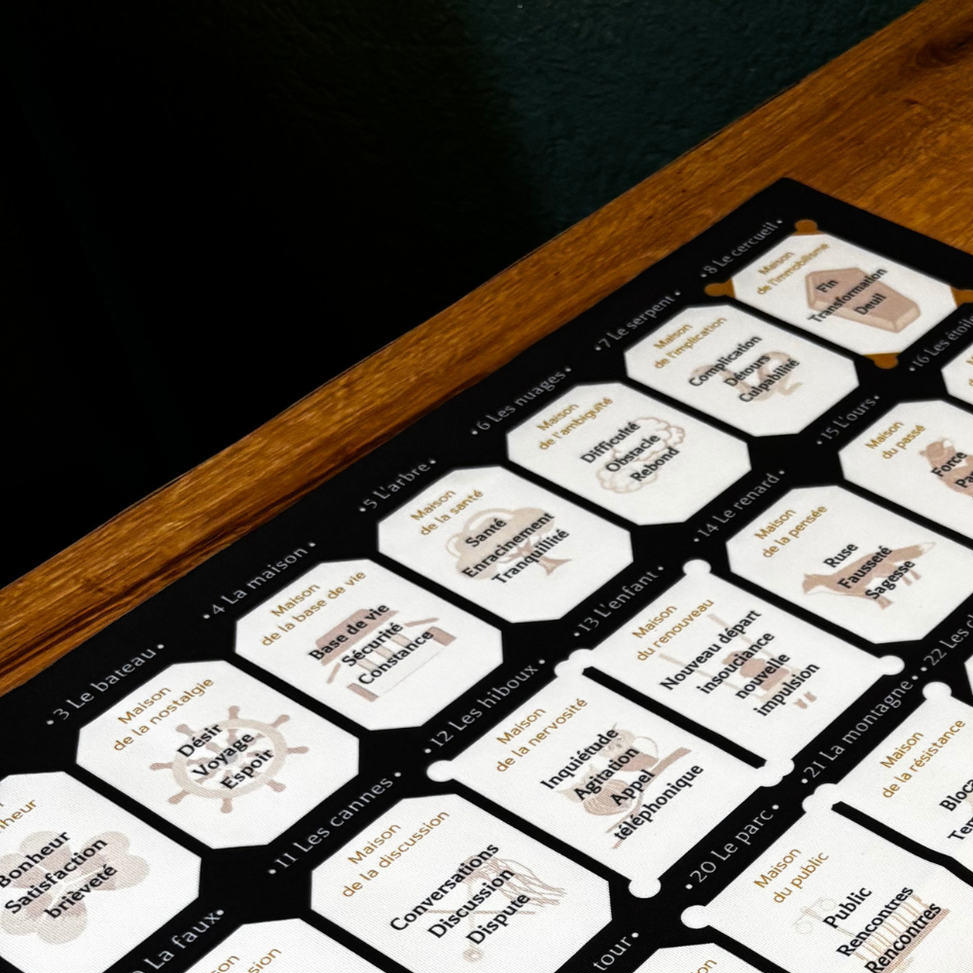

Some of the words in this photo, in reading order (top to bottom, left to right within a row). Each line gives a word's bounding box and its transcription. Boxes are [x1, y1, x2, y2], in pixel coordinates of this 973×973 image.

[807, 268, 888, 323] Transformation
[814, 278, 840, 294] Fin
[852, 291, 888, 316] Deuil
[687, 335, 763, 388] Complication
[722, 354, 772, 388] Détours
[738, 357, 801, 403] Culpabilité
[579, 421, 641, 465] Difficulté
[604, 434, 662, 473] Obstacle
[628, 445, 681, 483] Rebond
[930, 451, 969, 479] Force
[460, 511, 556, 579] Enracinement
[464, 517, 508, 549] Santé
[490, 528, 570, 584] Tranquillité
[211, 603, 226, 616] 4
[219, 588, 249, 606] La
[245, 547, 309, 591] maison
[577, 616, 601, 633] 13
[592, 570, 660, 619] L'enfant
[922, 647, 949, 667] 22
[937, 627, 971, 650] Les
[52, 707, 71, 721] 3
[64, 691, 96, 710] Le
[89, 647, 158, 694] bateau
[175, 723, 223, 759] Désir
[191, 733, 256, 777] Voyage
[539, 728, 620, 791] Inquiétude
[218, 748, 274, 791] Espoir
[573, 747, 641, 802] Agitation
[609, 768, 657, 808] Appel
[613, 764, 705, 841] téléphonique
[341, 881, 364, 898] de
[358, 868, 380, 882] la
[378, 811, 450, 869] discussion
[346, 823, 402, 865] Maison
[688, 860, 718, 884] 20
[709, 842, 739, 862] Le
[734, 809, 774, 846] parc
[3, 838, 109, 915] Satisfaction
[42, 862, 119, 920] brièveté
[389, 843, 500, 932] Conversations
[426, 869, 516, 939] Discussion
[465, 893, 532, 946] Dispute
[821, 886, 873, 930] Public
[835, 886, 915, 958] Rencontres
[142, 949, 176, 971] La
[170, 911, 222, 950] faux
